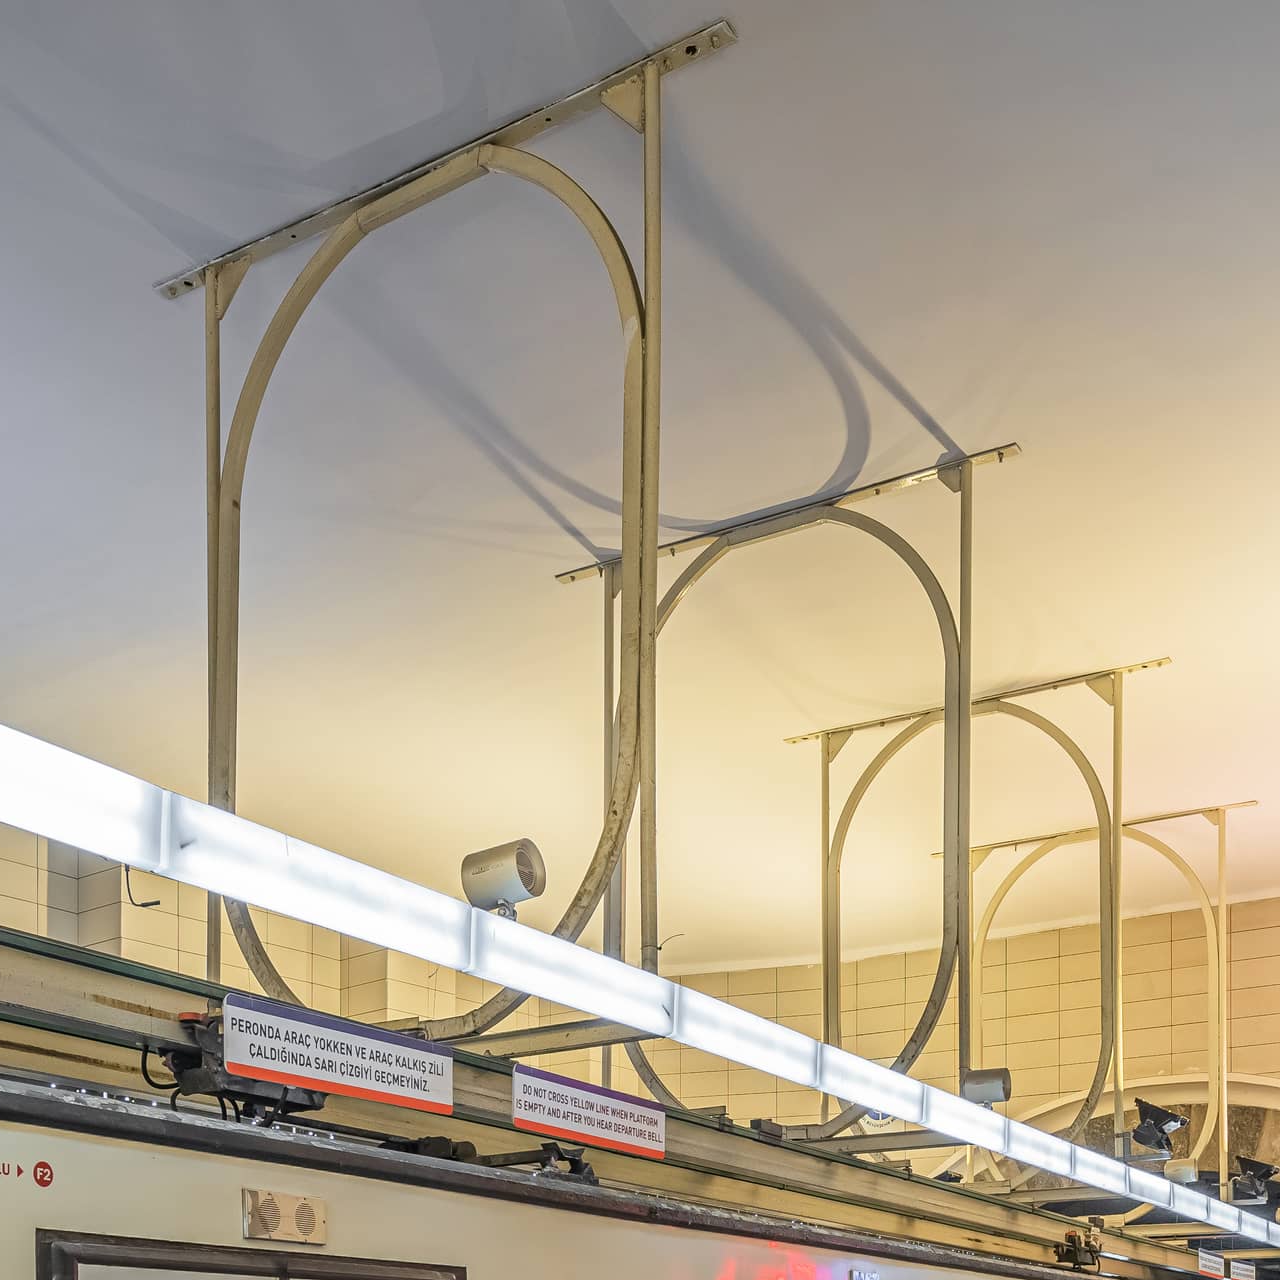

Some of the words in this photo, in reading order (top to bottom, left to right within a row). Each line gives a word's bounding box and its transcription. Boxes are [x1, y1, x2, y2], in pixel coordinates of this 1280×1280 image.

[231, 1017, 281, 1041] PERONDA
[284, 1030, 311, 1049] ARAÇ
[313, 1037, 353, 1057] YOKKEN
[355, 1047, 367, 1060] VE
[369, 1050, 393, 1066] ARAÇ
[395, 1055, 427, 1075] KALKIŞ
[428, 1060, 444, 1077] ZİLİ
[249, 1043, 313, 1069] ÇALDIĞINDA
[315, 1058, 337, 1073] SARI
[339, 1062, 372, 1081] ÇİZGİYİ
[374, 1069, 430, 1093] GEÇMEYİNİZ.
[515, 1098, 523, 1110] IS
[524, 1100, 546, 1115] EMPTY
[547, 1106, 561, 1119] AND
[562, 1111, 582, 1124] AFTER
[583, 1116, 596, 1127] YOU
[596, 1119, 613, 1131] HEAR
[613, 1123, 647, 1140] DEPARTURE
[522, 1083, 533, 1096] DO
[533, 1087, 547, 1100] NOT
[548, 1090, 569, 1105] CROSS
[570, 1095, 595, 1112] YELLOW
[595, 1103, 610, 1115] LINE
[610, 1106, 628, 1120] WHEN
[629, 1111, 658, 1128] PLATFORM
[36, 1167, 51, 1181] F2
